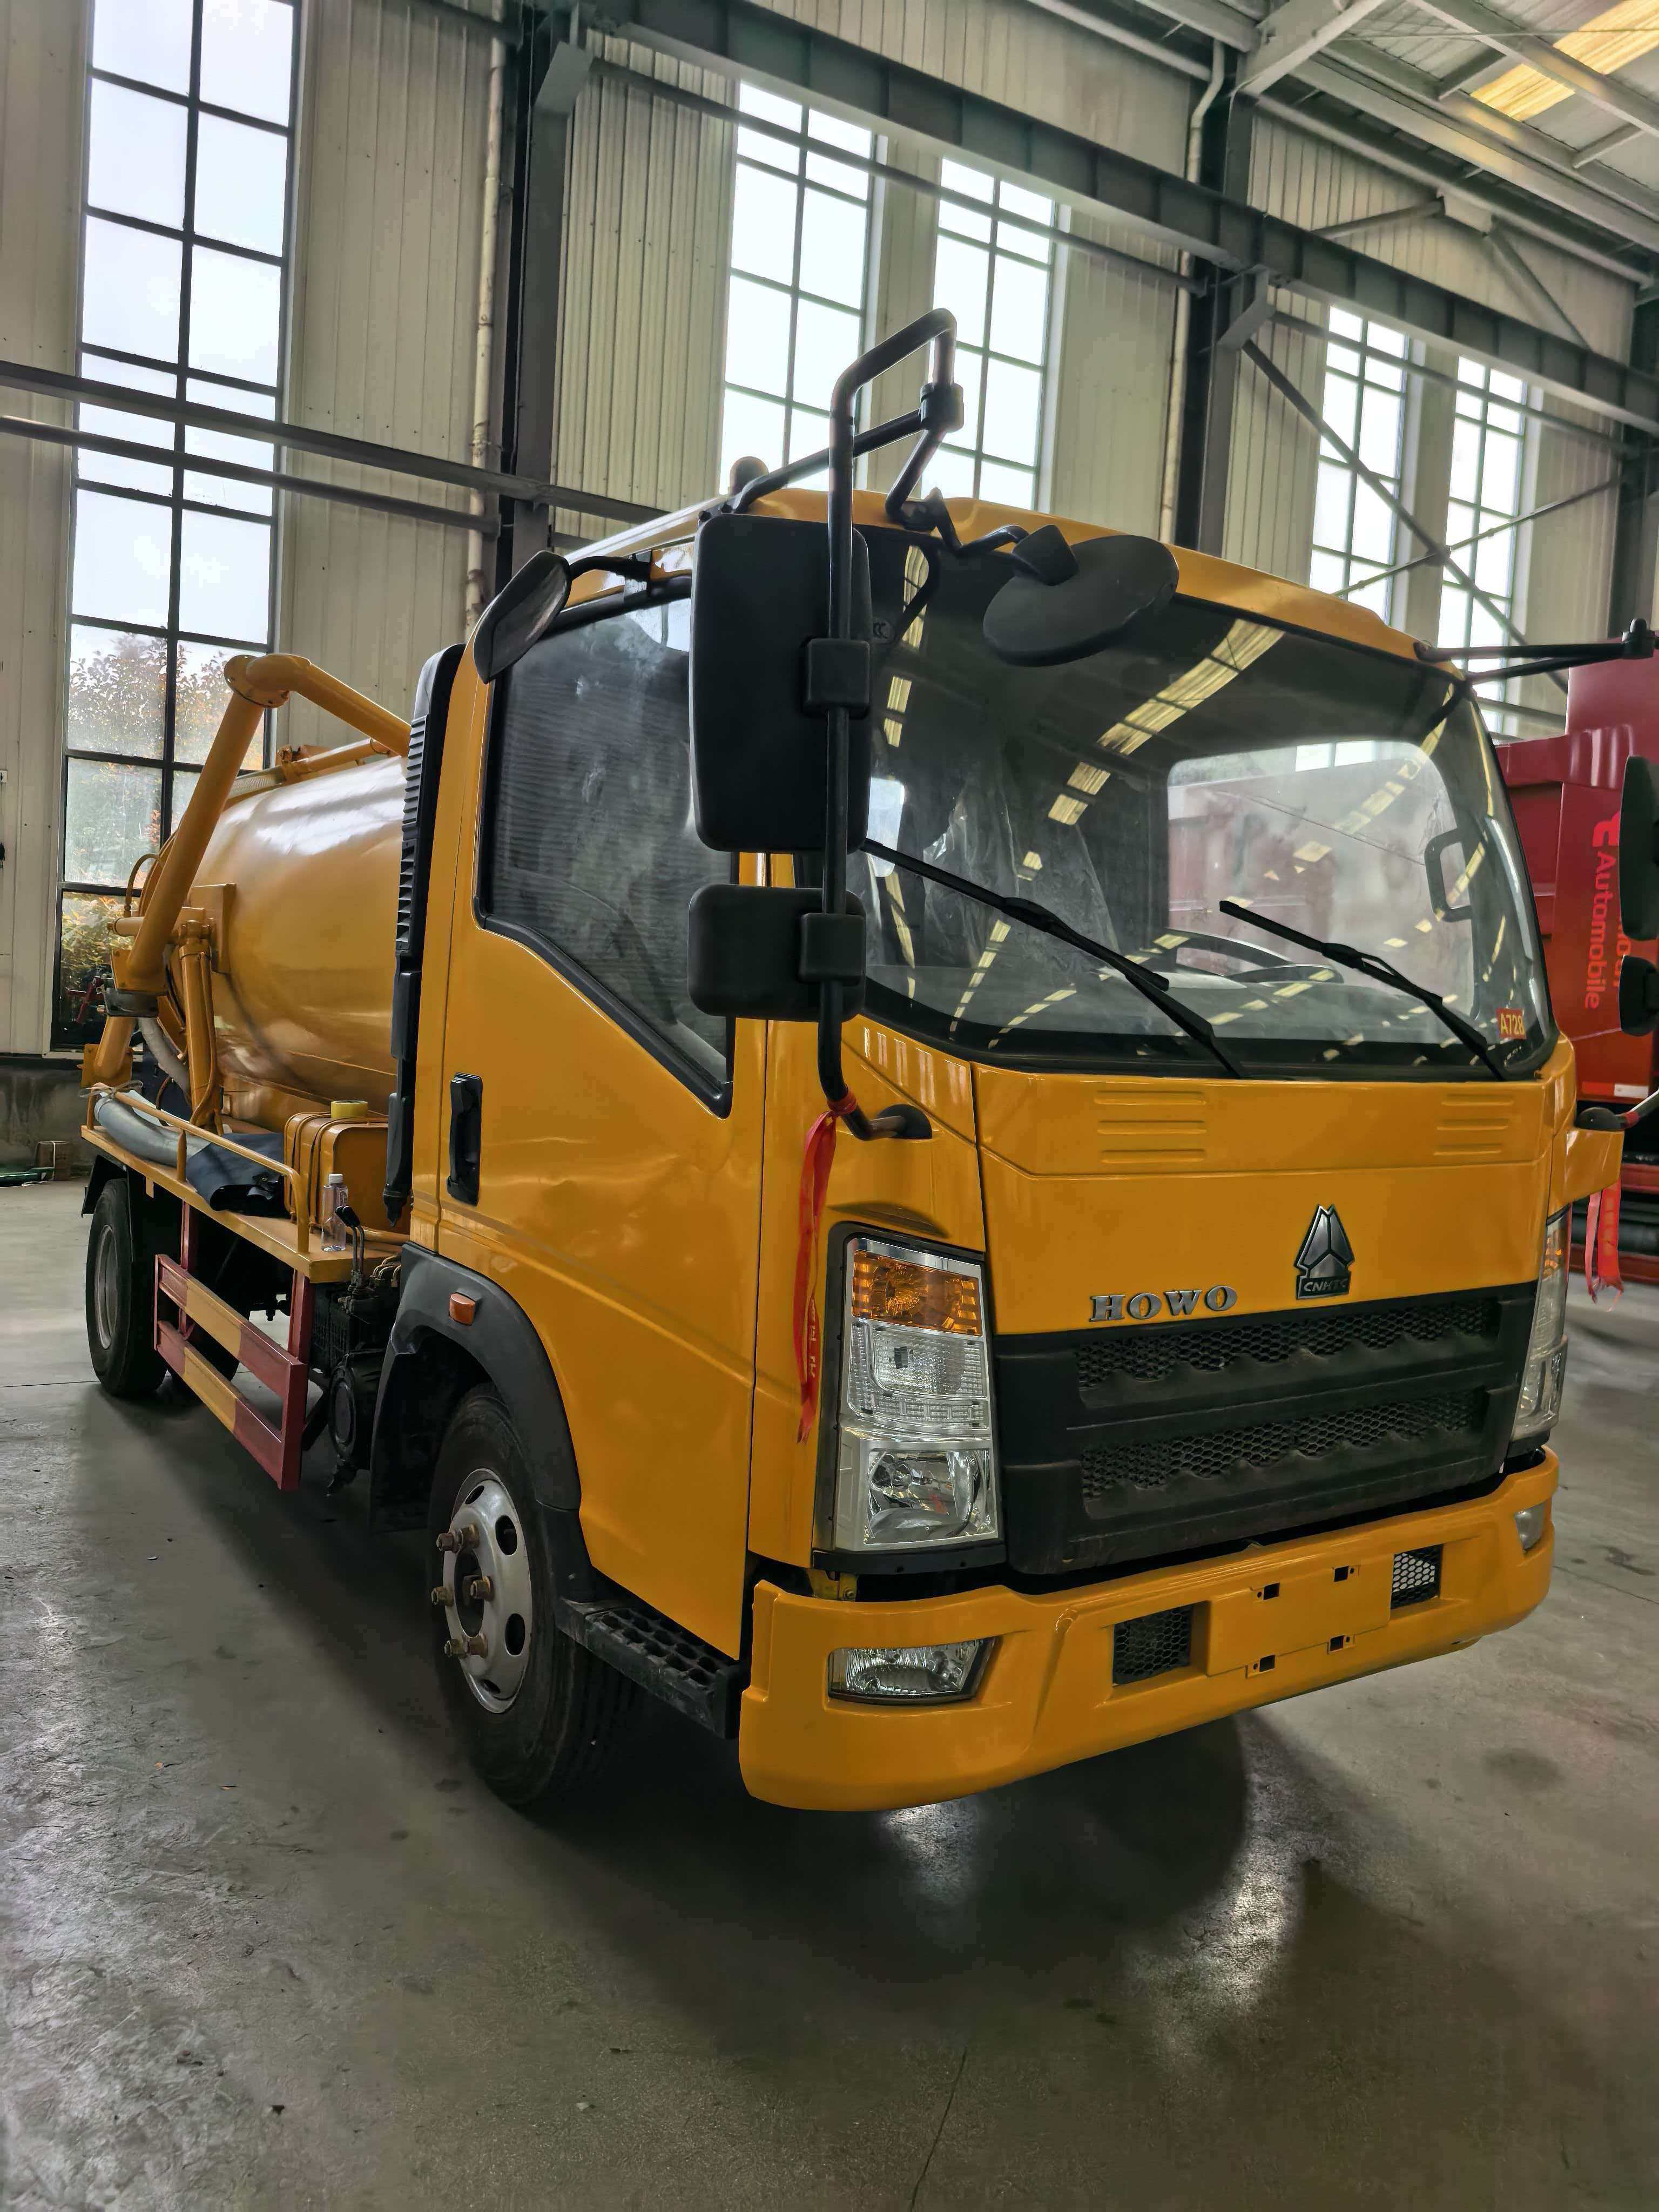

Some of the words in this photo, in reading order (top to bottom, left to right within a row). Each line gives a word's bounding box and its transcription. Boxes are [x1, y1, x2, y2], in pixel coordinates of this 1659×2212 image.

[1584, 851, 1616, 1009] Automobile
[1500, 1013, 1525, 1035] A728
[1304, 1278, 1347, 1292] CNHTC
[1089, 1285, 1238, 1322] HOWO
